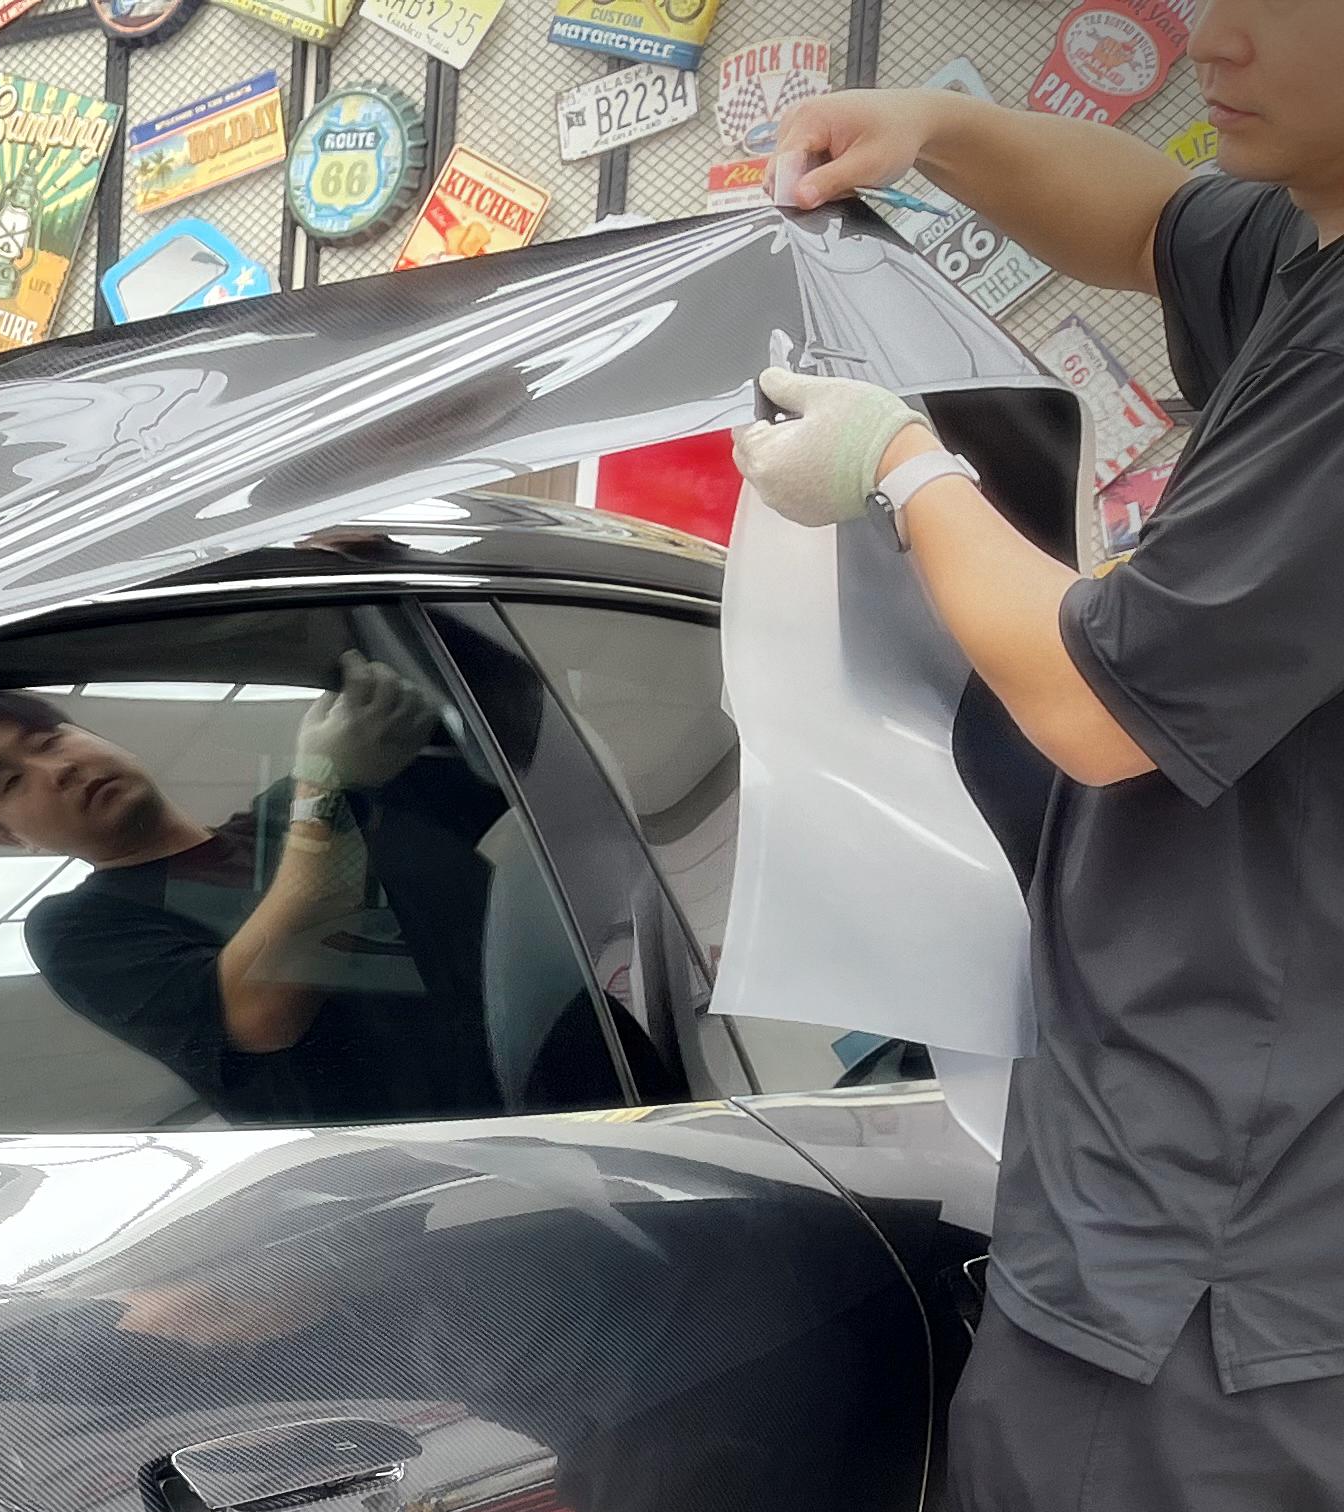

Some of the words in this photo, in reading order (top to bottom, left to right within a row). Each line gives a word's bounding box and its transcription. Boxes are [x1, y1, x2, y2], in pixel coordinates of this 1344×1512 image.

[552, 21, 676, 59] MOTORCYCLE
[591, 7, 644, 29] CUSTOM
[594, 65, 654, 96] ALASKA
[721, 42, 782, 91] STOCK
[792, 41, 828, 73] CAR
[595, 70, 689, 136] B2234
[1034, 72, 1109, 125] PARTS
[188, 97, 279, 165] HOLIDAY
[324, 131, 376, 150] ROUTE
[320, 160, 369, 198] 66
[440, 166, 535, 236] KITCHEN
[935, 221, 996, 281] 66
[1063, 354, 1091, 386] 66
